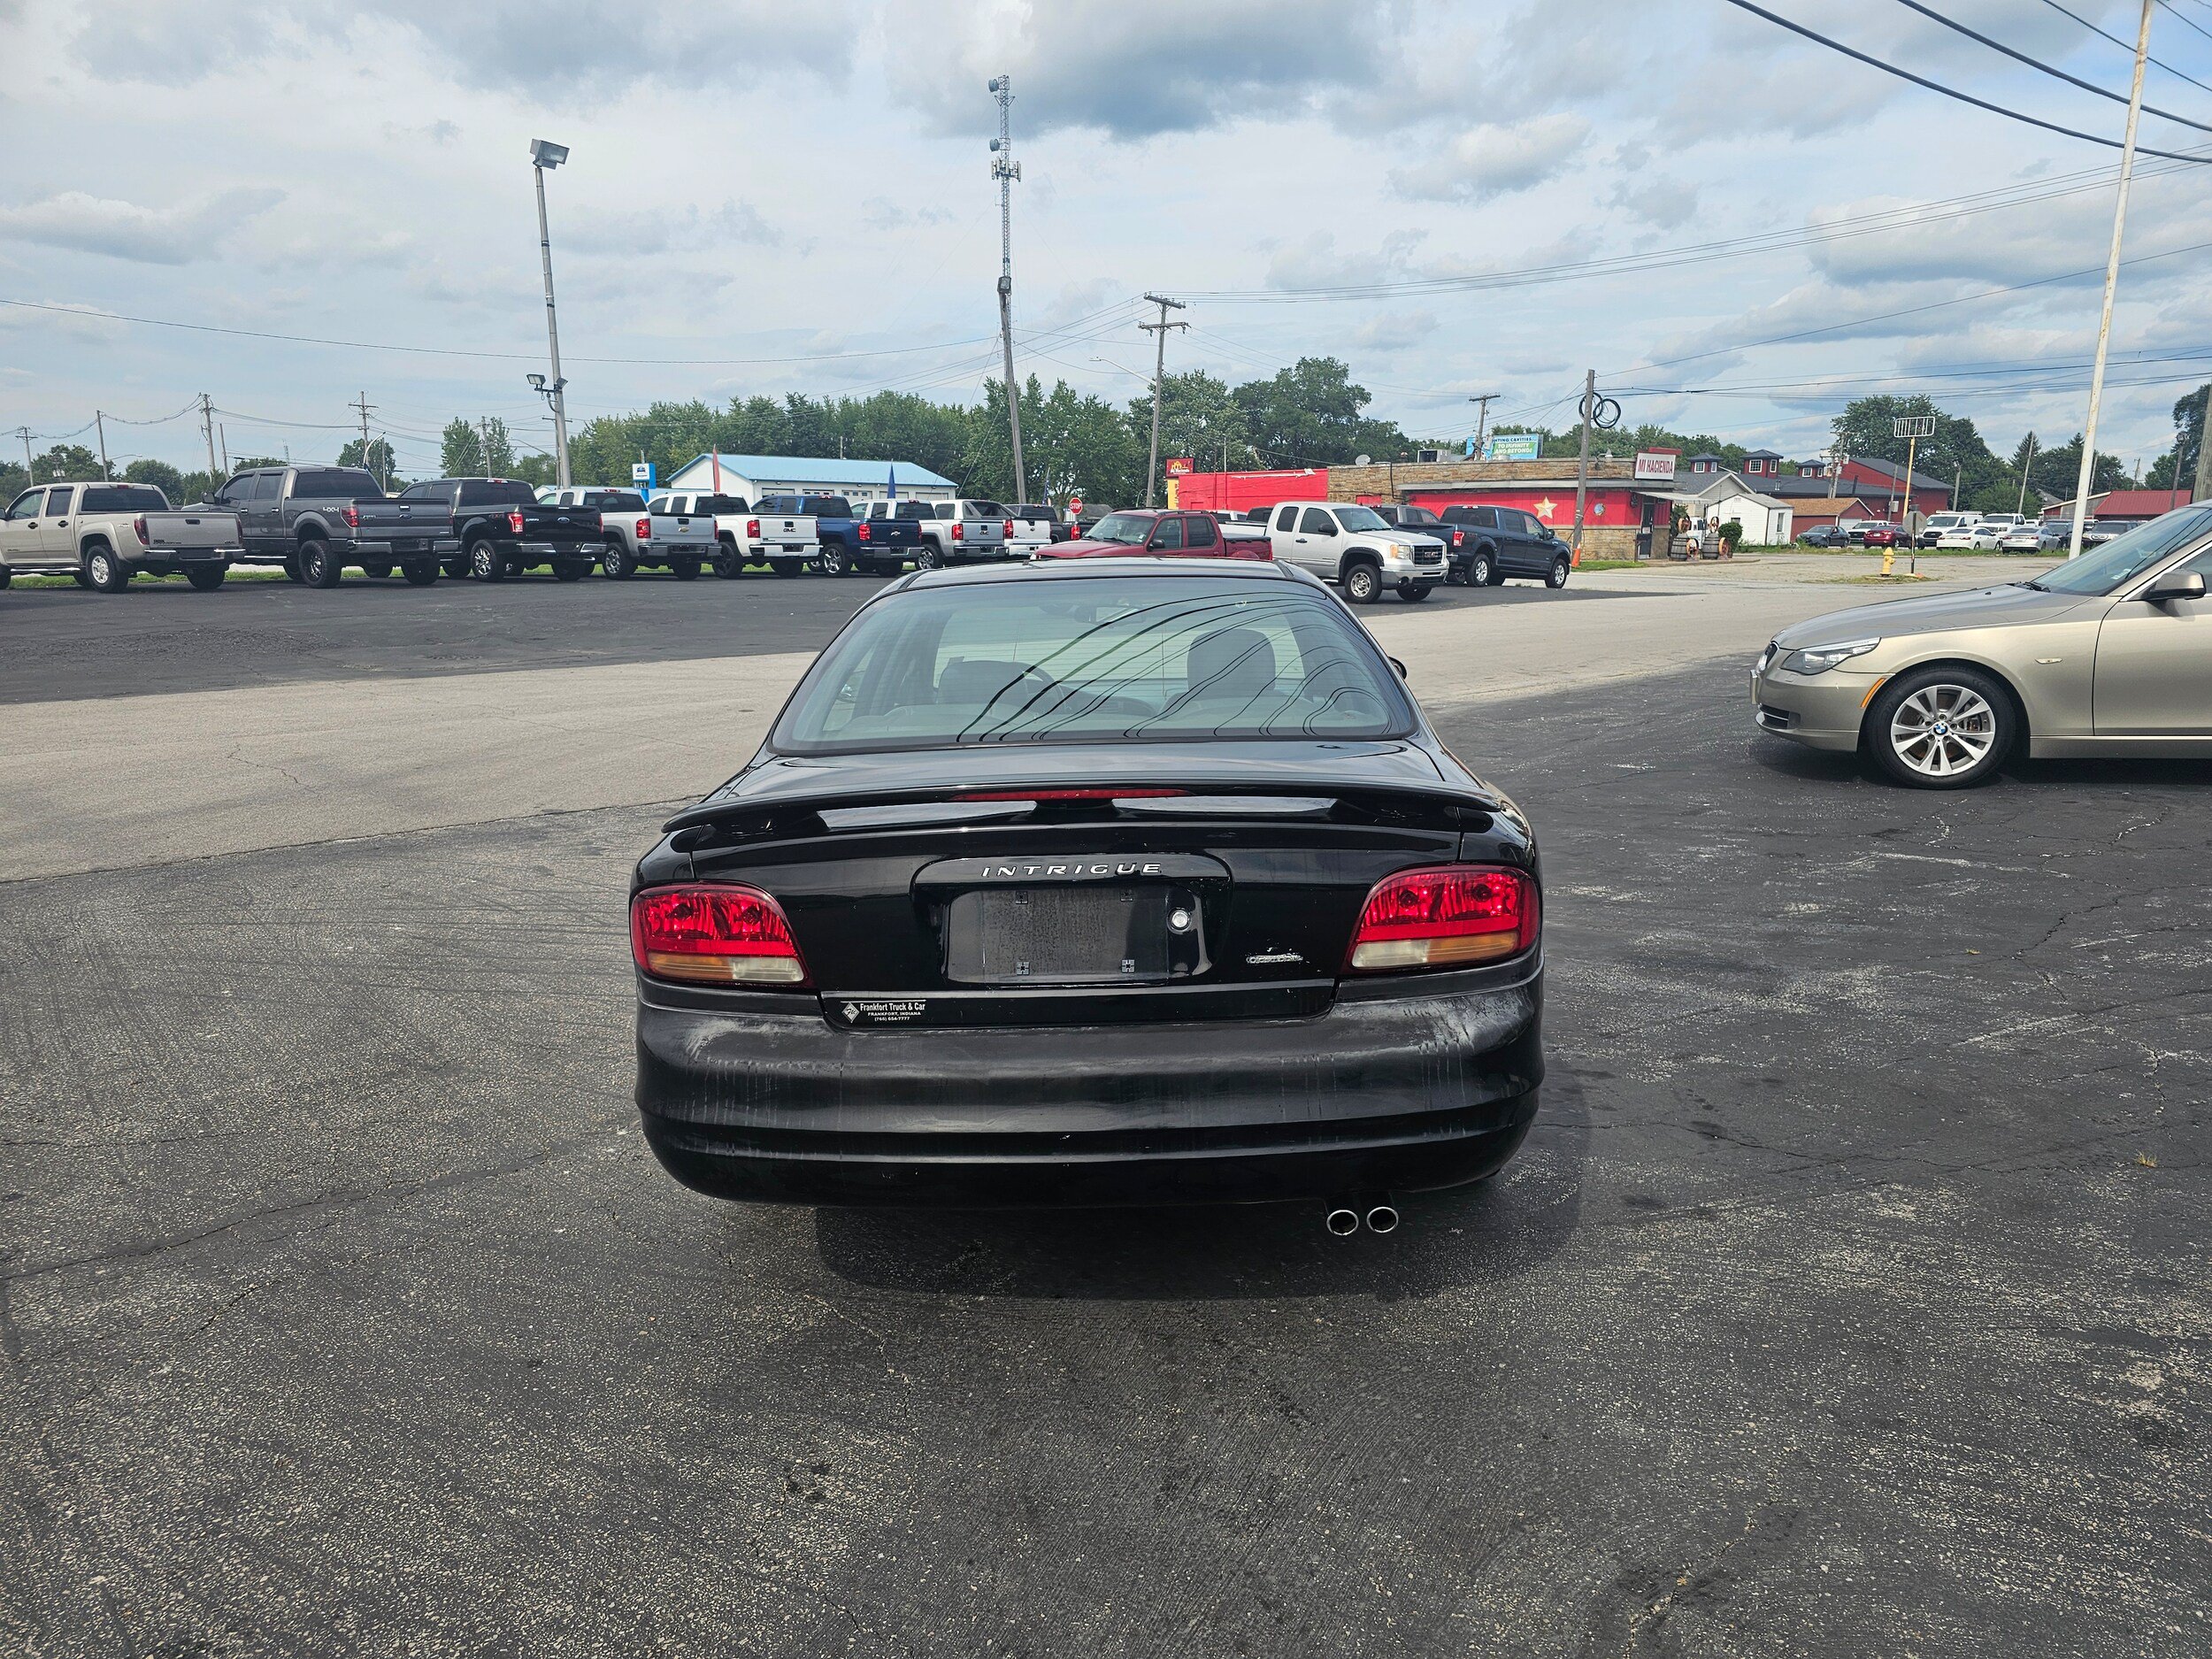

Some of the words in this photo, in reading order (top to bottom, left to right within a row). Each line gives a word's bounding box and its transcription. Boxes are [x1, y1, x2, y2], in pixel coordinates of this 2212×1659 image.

[1638, 459, 1647, 472] MI
[1646, 459, 1673, 473] HACIENDA
[981, 863, 1162, 878] INTRIGUE
[860, 1002, 887, 1011] Frankfort
[908, 1002, 913, 1010] &
[914, 1002, 926, 1010] Car
